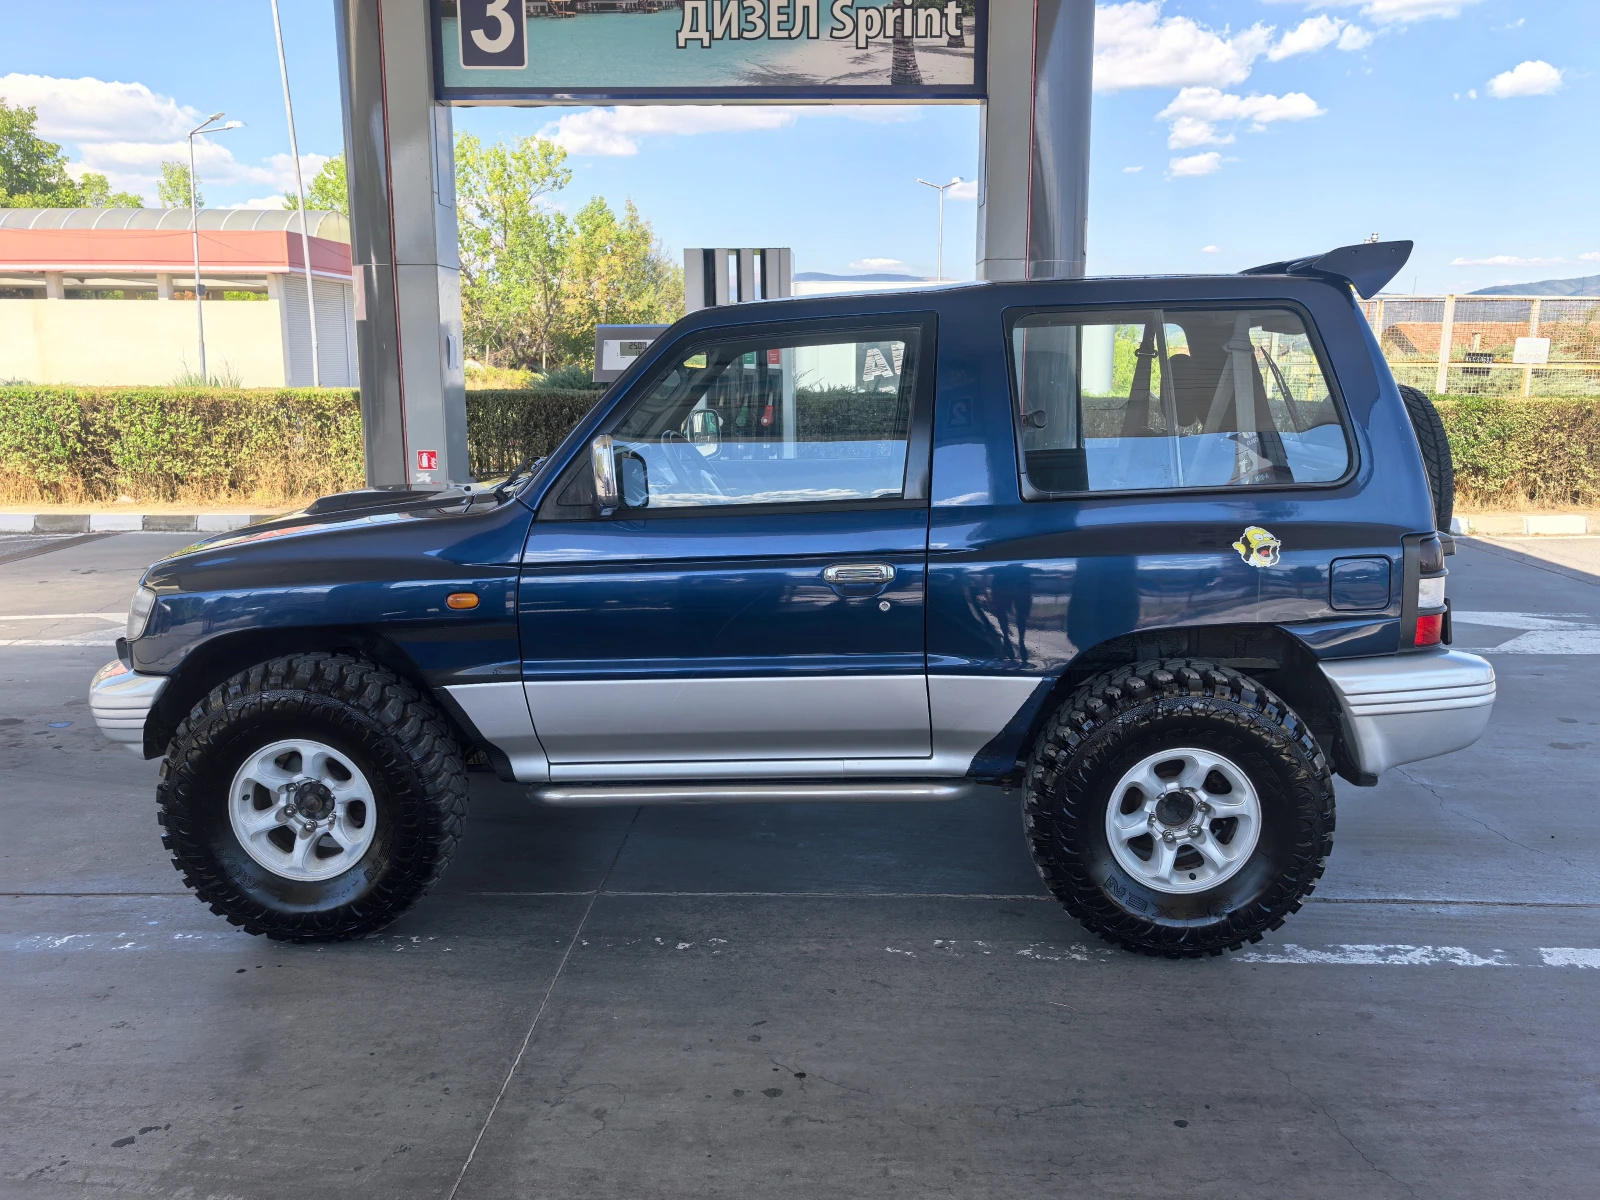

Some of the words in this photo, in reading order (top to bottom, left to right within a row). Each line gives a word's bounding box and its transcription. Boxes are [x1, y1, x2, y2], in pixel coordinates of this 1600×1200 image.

[470, 0, 515, 53] 3
[676, 0, 820, 49] ДИЗЕЛ
[829, 0, 965, 49] Sprint
